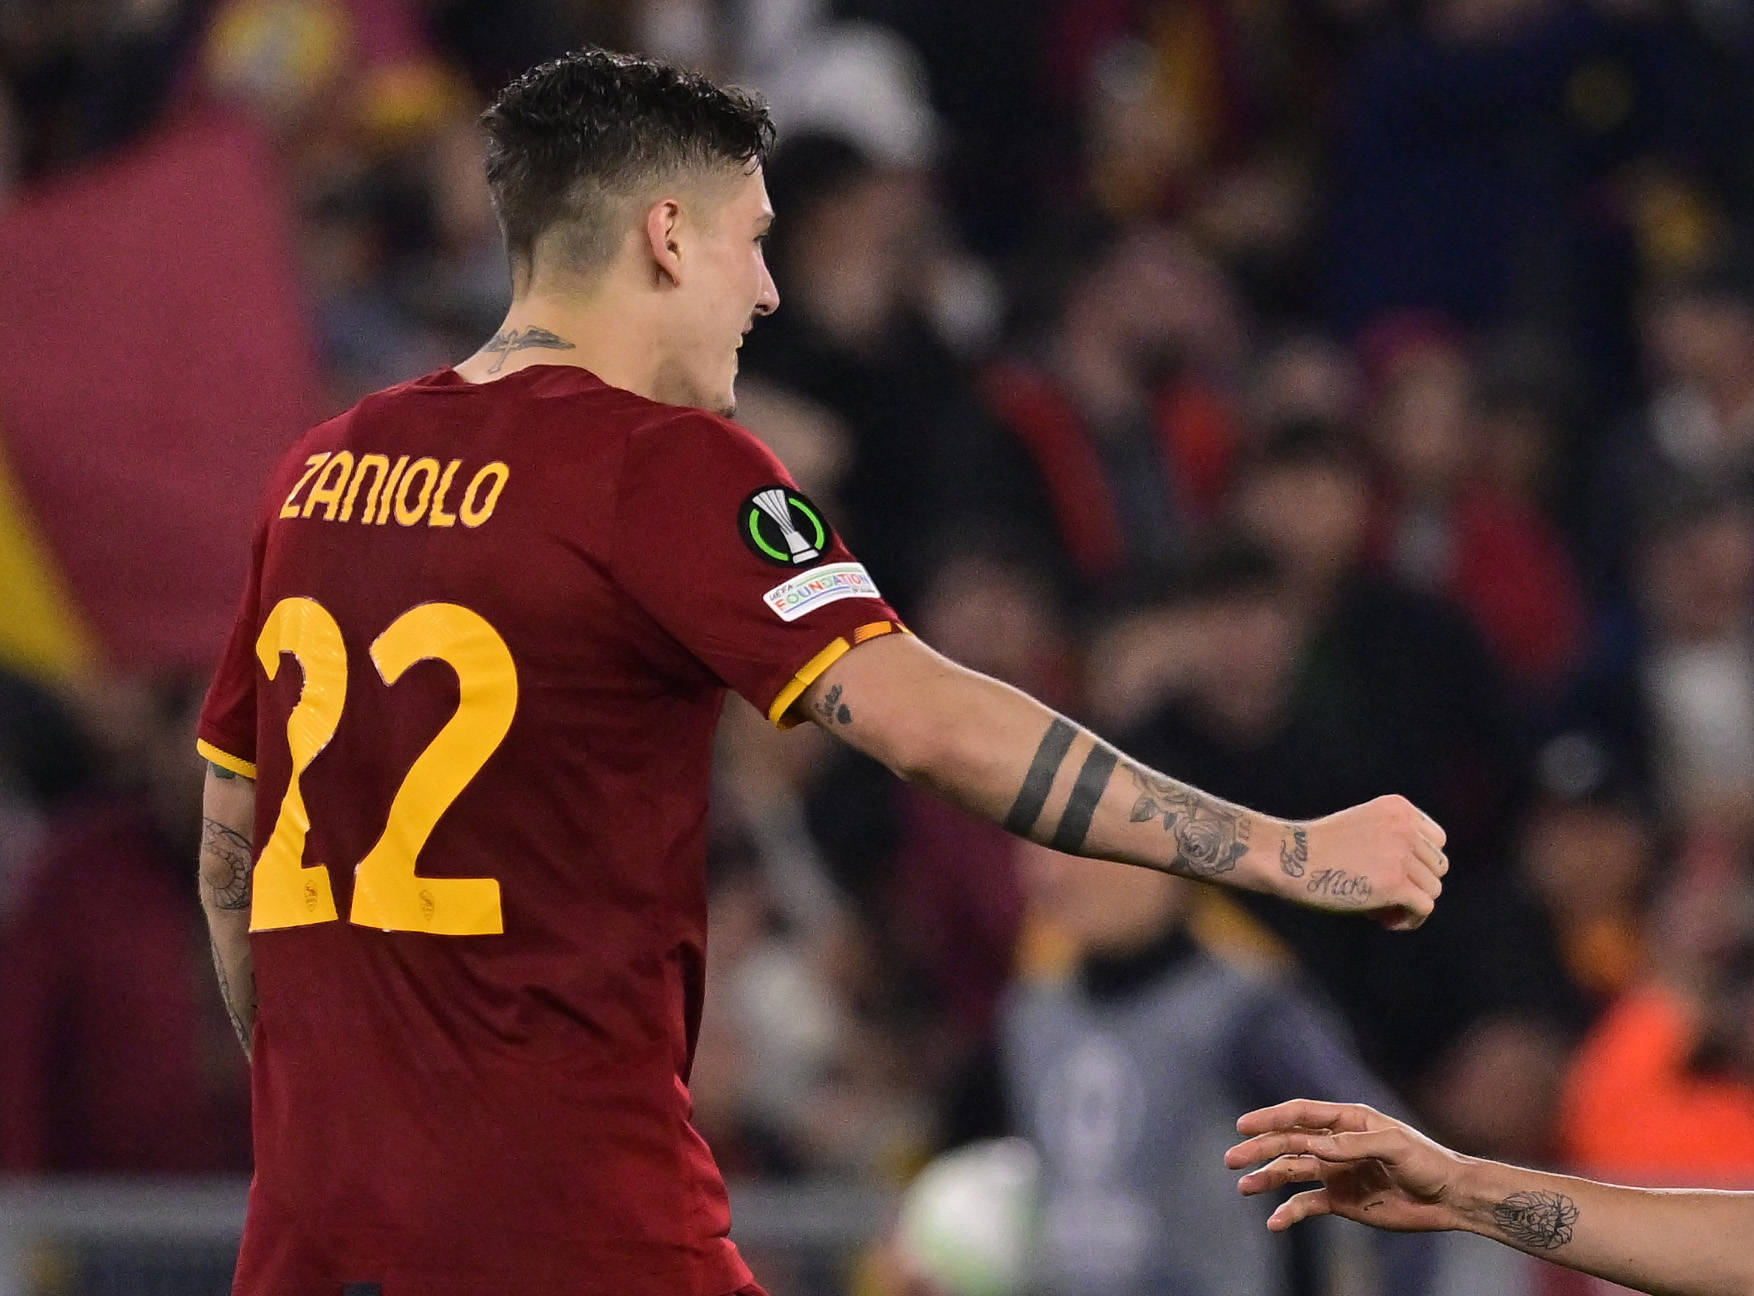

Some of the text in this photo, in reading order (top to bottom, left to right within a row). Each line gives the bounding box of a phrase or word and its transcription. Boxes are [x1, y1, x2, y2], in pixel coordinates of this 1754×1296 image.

[279, 450, 510, 528] ZANIOLO
[775, 573, 870, 611] FOUNDATION
[249, 597, 518, 935] 22
